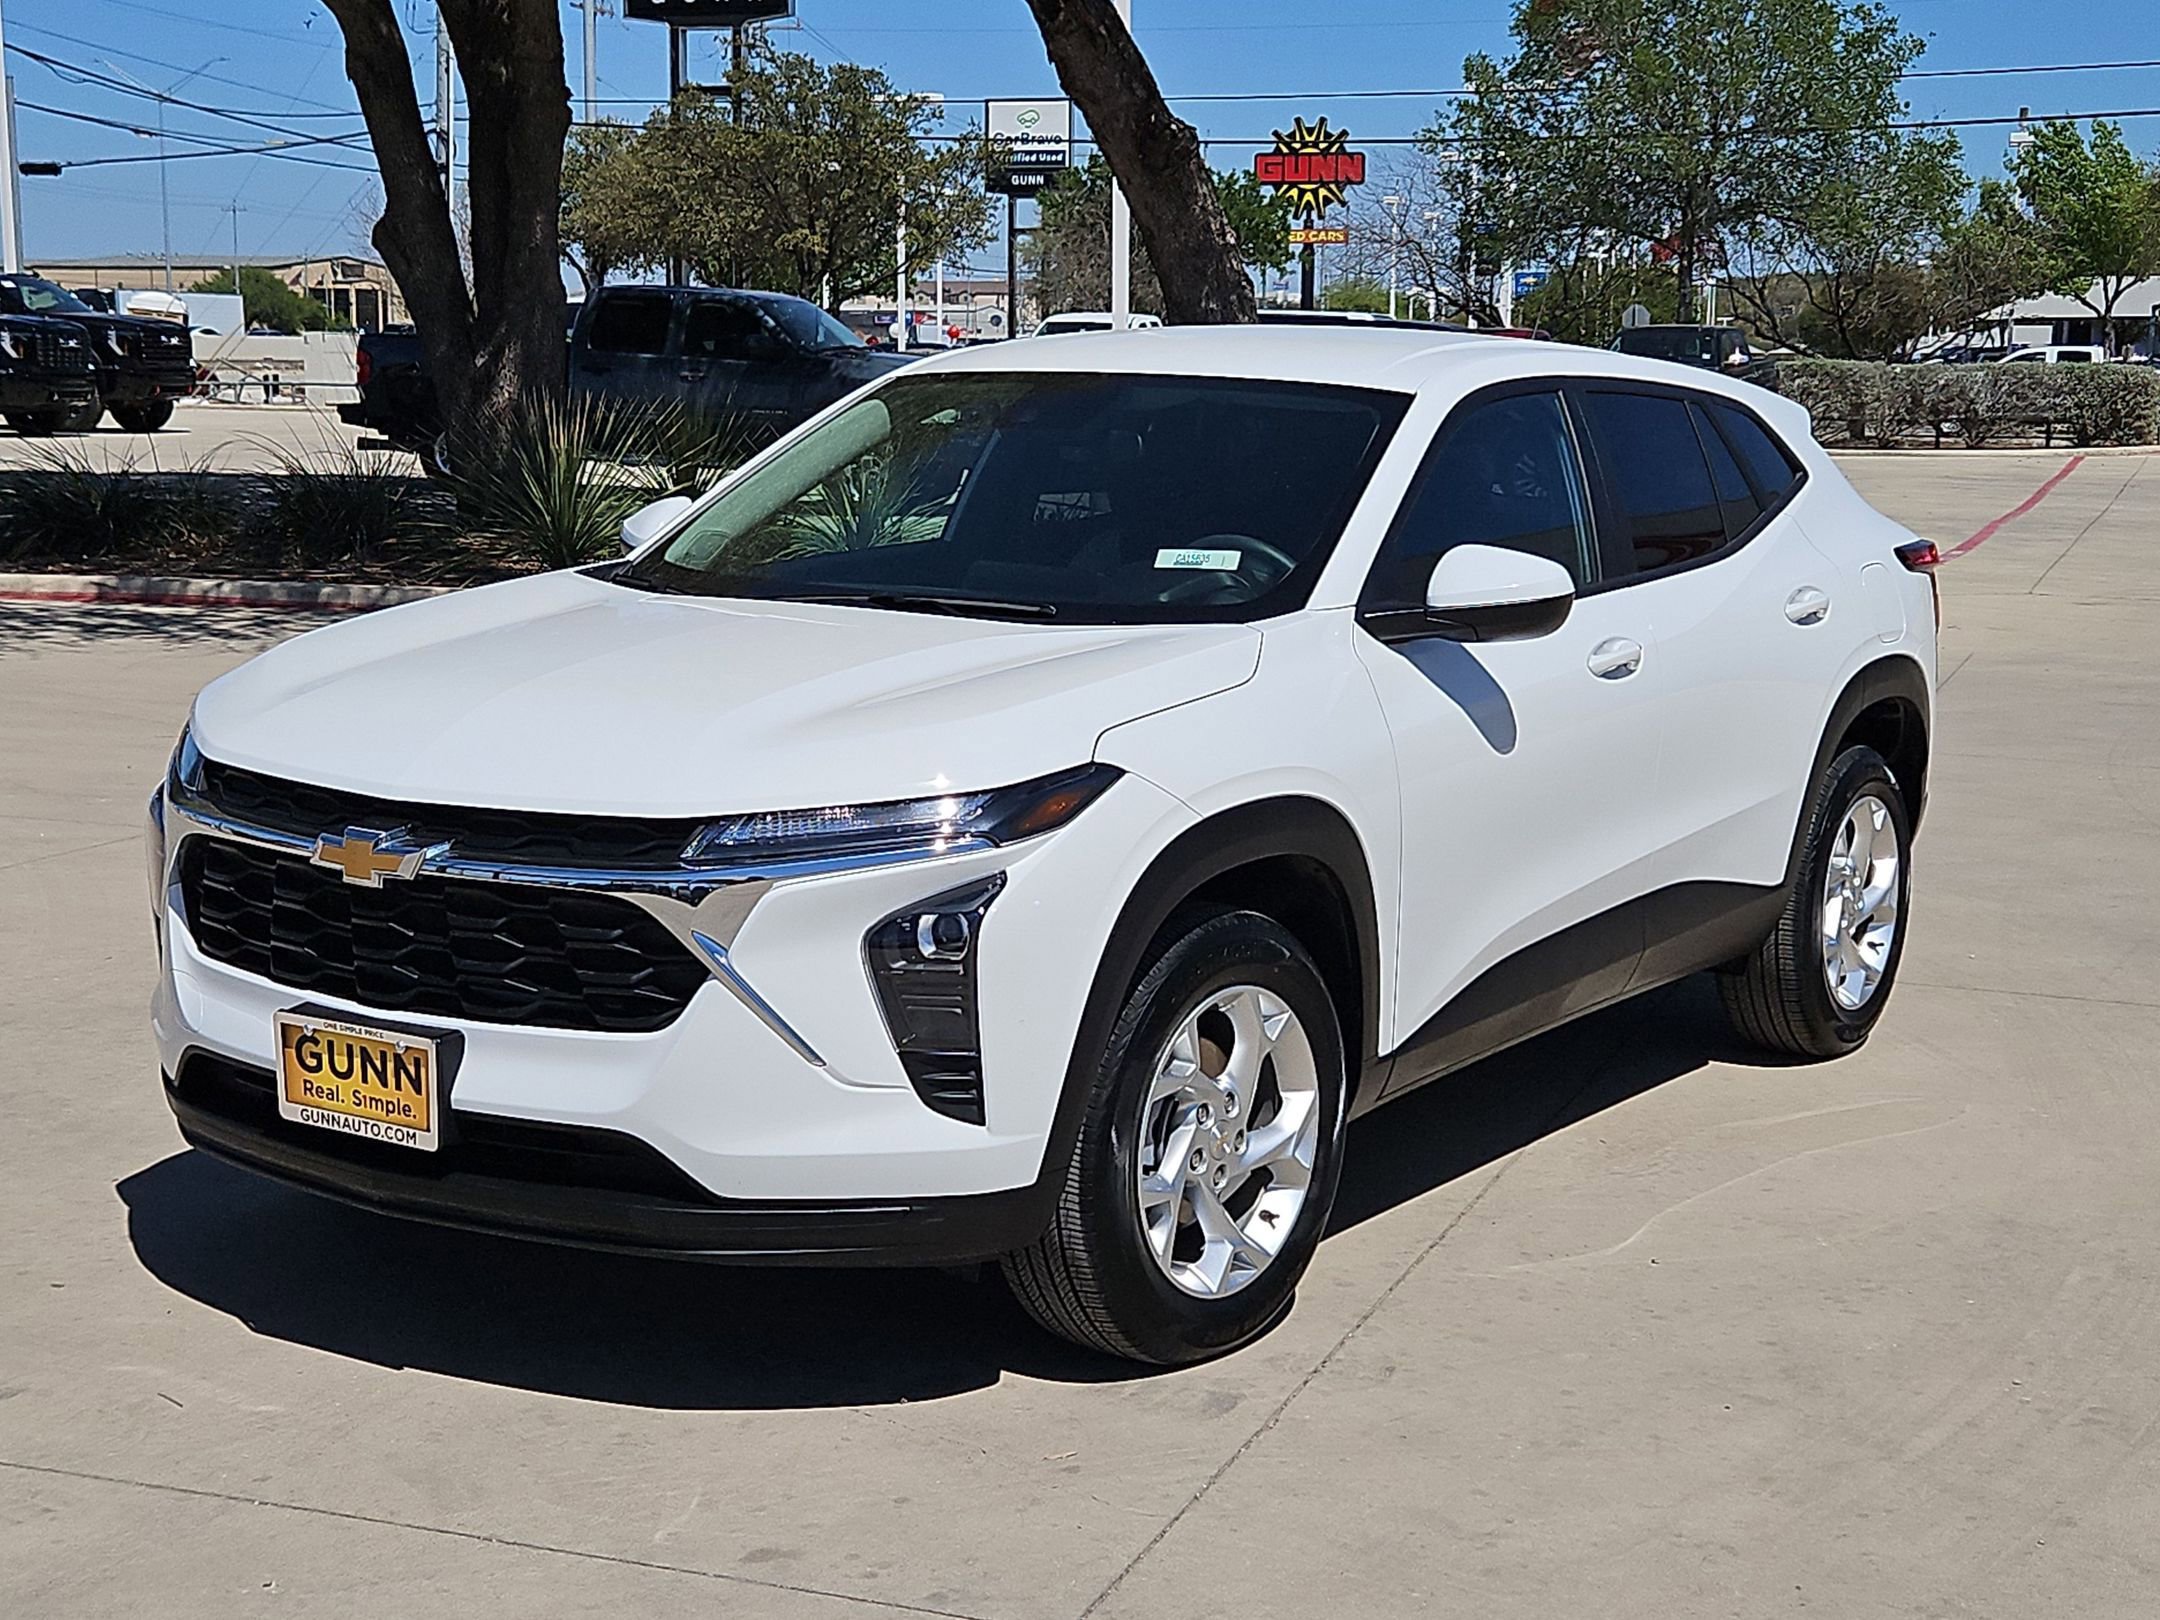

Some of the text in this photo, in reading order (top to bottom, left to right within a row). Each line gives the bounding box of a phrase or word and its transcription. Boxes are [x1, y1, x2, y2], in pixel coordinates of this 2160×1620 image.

[1011, 175, 1044, 185] GUNN
[1257, 155, 1363, 181] GUNN
[1308, 231, 1344, 242] CARS
[322, 1021, 385, 1039] ONE SIMPLE PRICE
[295, 1033, 422, 1096] GUNN
[303, 1079, 345, 1104] Real.
[300, 1108, 417, 1145] GUNNAUTO.COM
